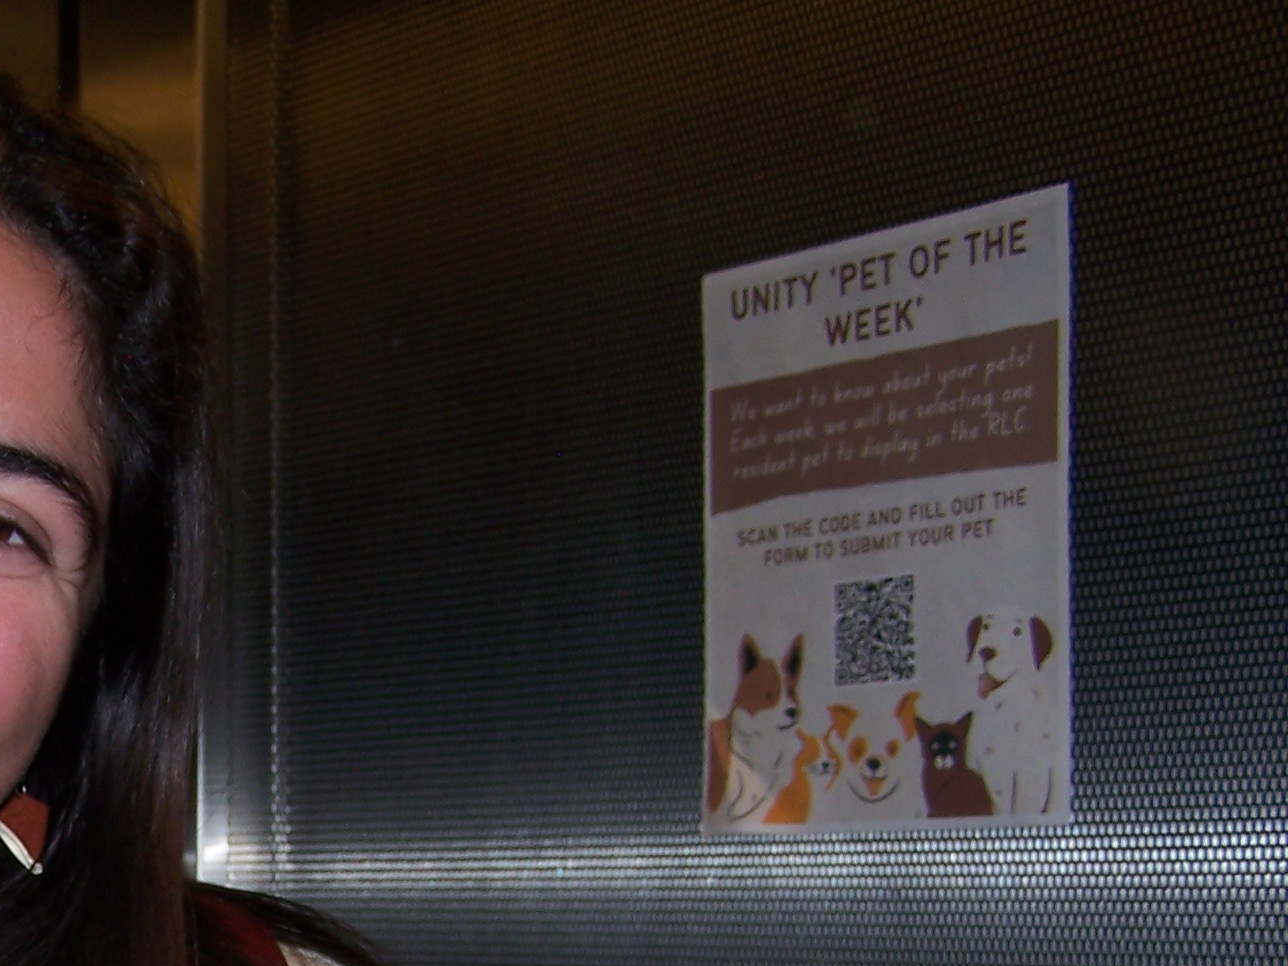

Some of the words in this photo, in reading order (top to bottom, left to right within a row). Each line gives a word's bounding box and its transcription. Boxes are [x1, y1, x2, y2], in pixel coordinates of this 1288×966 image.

[730, 270, 819, 321] UNITY
[829, 252, 896, 297] 'PET
[909, 238, 952, 279] OF
[964, 219, 1028, 267] THE
[824, 297, 923, 347] WEEK'
[810, 386, 826, 407] to
[882, 362, 930, 394] about
[938, 363, 978, 400] your
[824, 420, 848, 436] we
[854, 403, 883, 429] will
[887, 401, 908, 424] be
[916, 387, 995, 418] selecting
[1002, 384, 1034, 402] one
[801, 443, 830, 478] pet
[836, 441, 854, 462] to
[860, 431, 919, 466] display
[926, 432, 944, 447] in
[951, 418, 981, 443] the
[737, 526, 780, 548] SCAN
[783, 518, 813, 538] THE
[818, 511, 862, 535] CODE
[867, 505, 902, 528] AND
[909, 501, 946, 522] FILL
[951, 493, 986, 516] OUT
[993, 487, 1028, 509] THE
[764, 545, 809, 567] FORM
[814, 540, 834, 560] TO
[839, 531, 901, 558] SUBMIT
[908, 524, 954, 548] YOUR
[961, 518, 994, 539] PET
